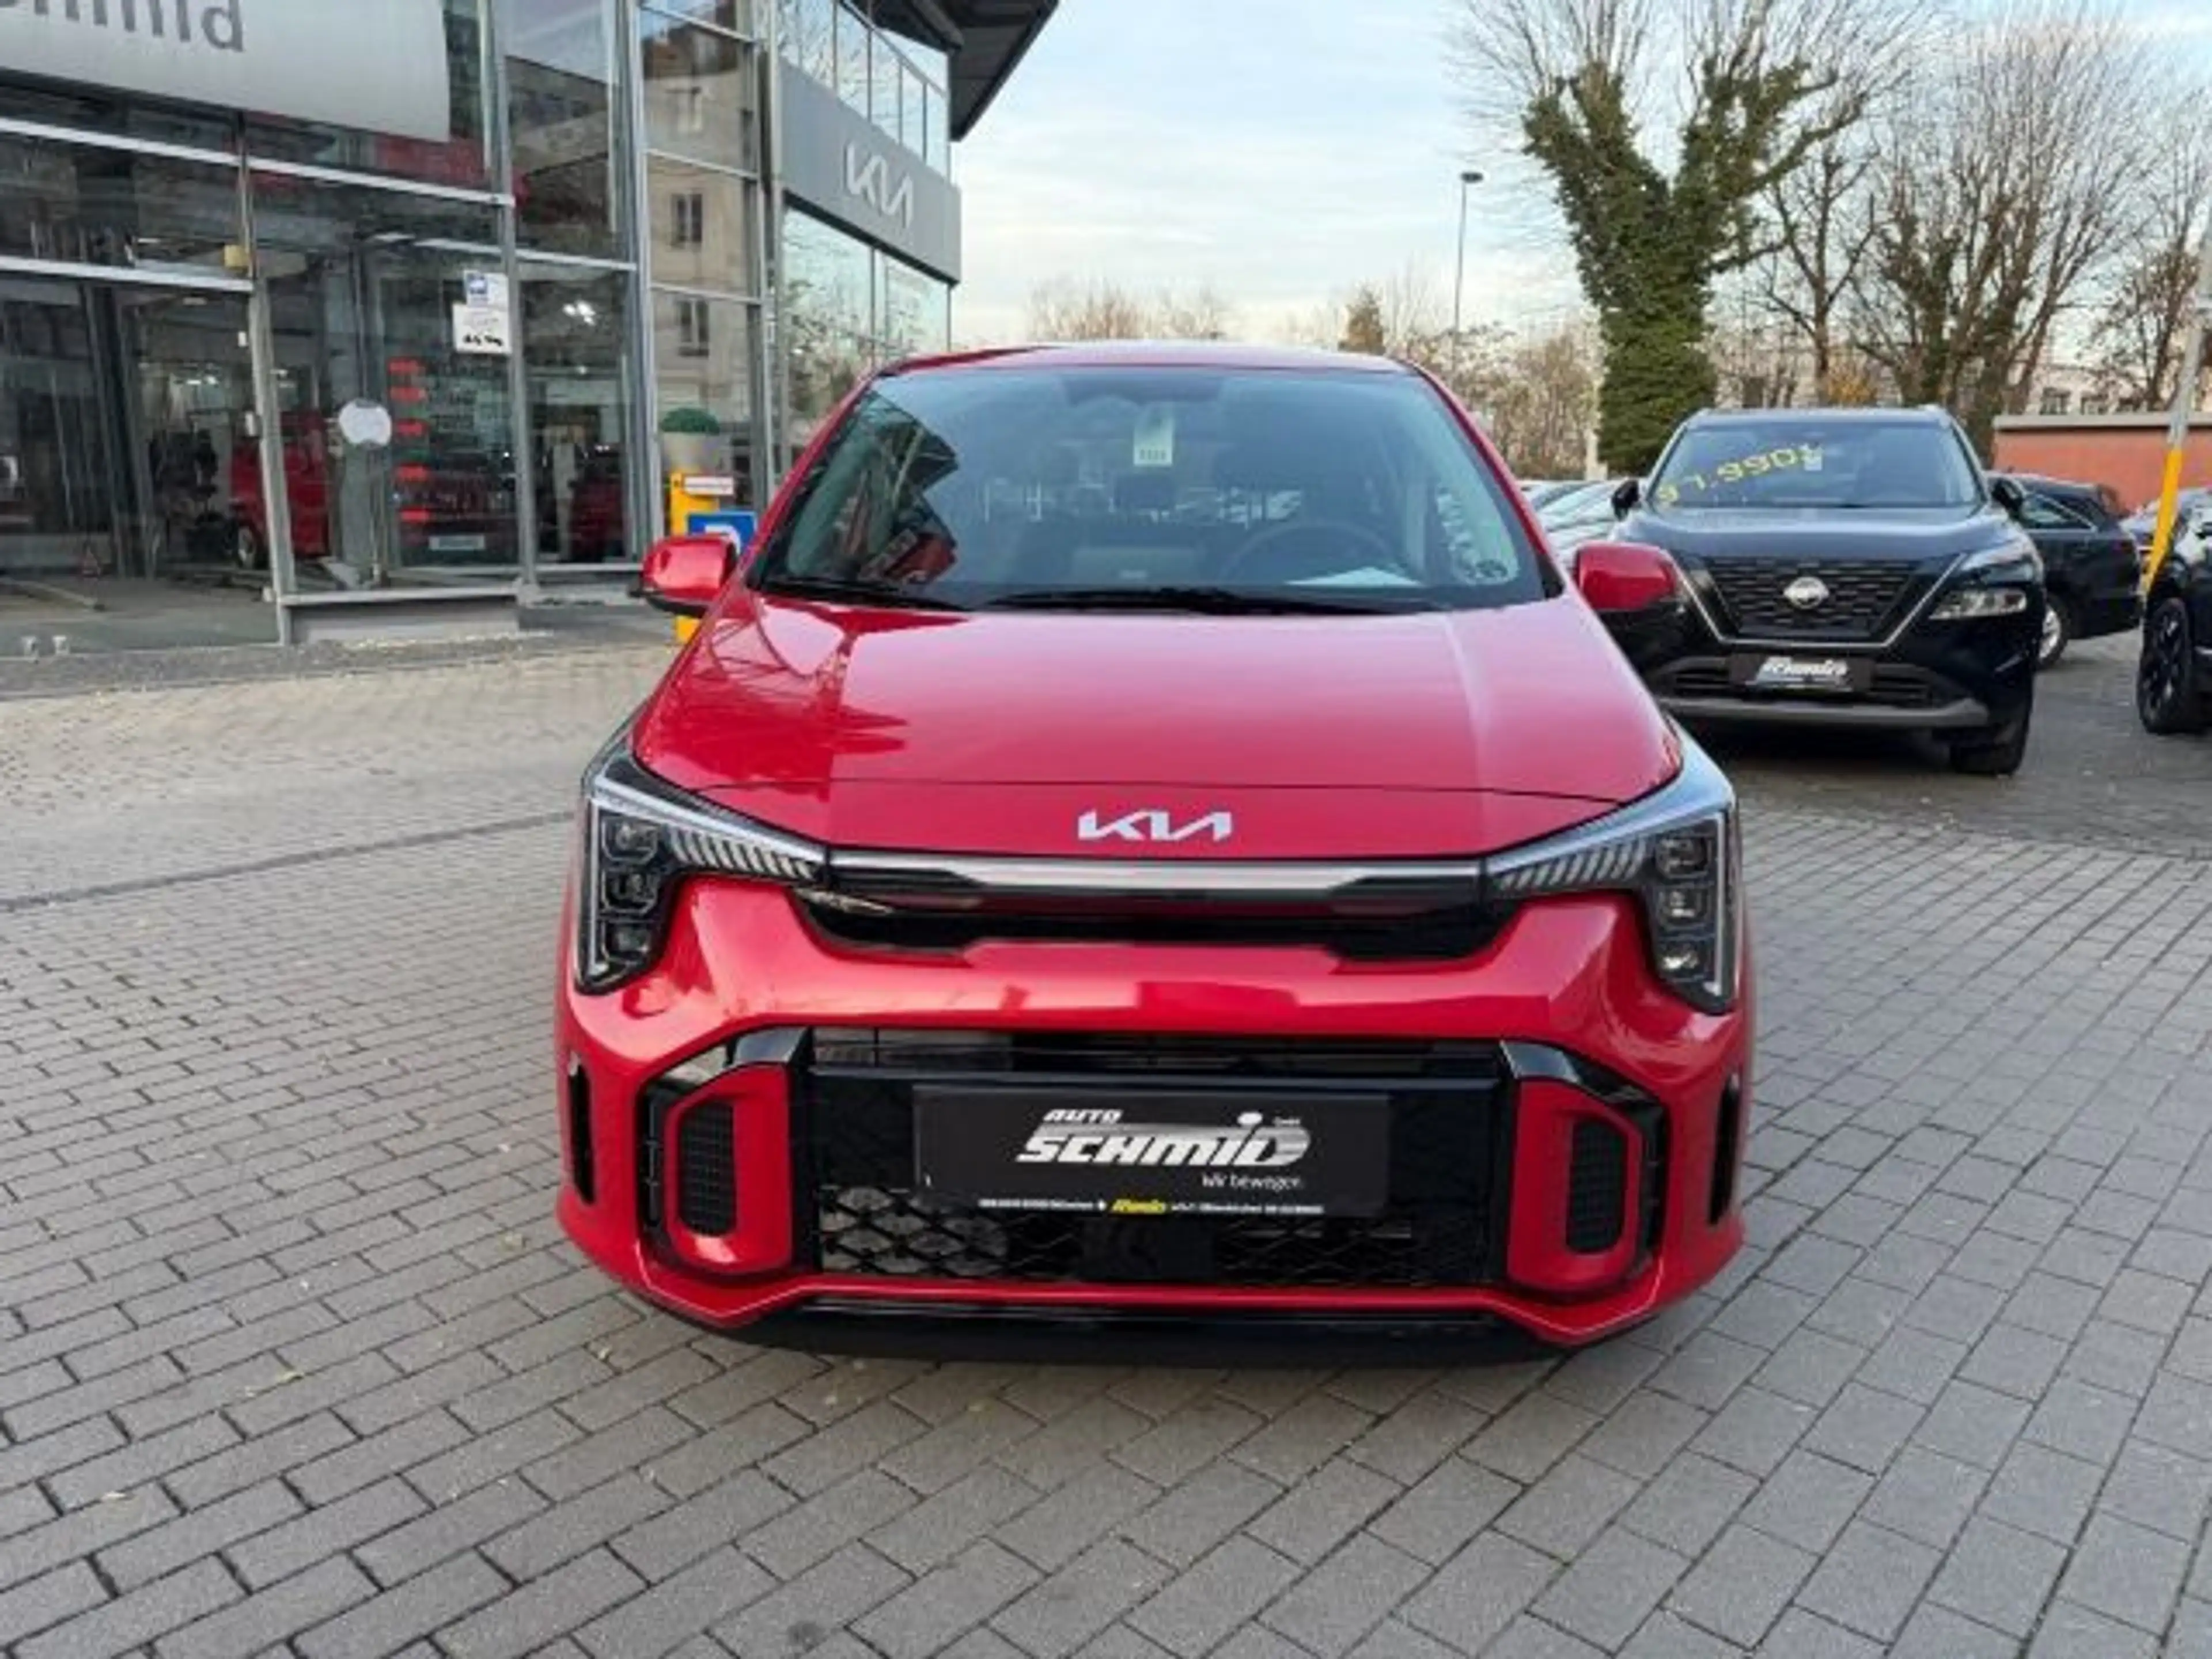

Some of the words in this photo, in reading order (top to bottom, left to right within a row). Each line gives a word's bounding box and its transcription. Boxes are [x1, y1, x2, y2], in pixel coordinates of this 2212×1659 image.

[1078, 809, 1232, 841] KIA
[1043, 1108, 1124, 1123] AUTO
[1015, 1111, 1311, 1166] SCHMID
